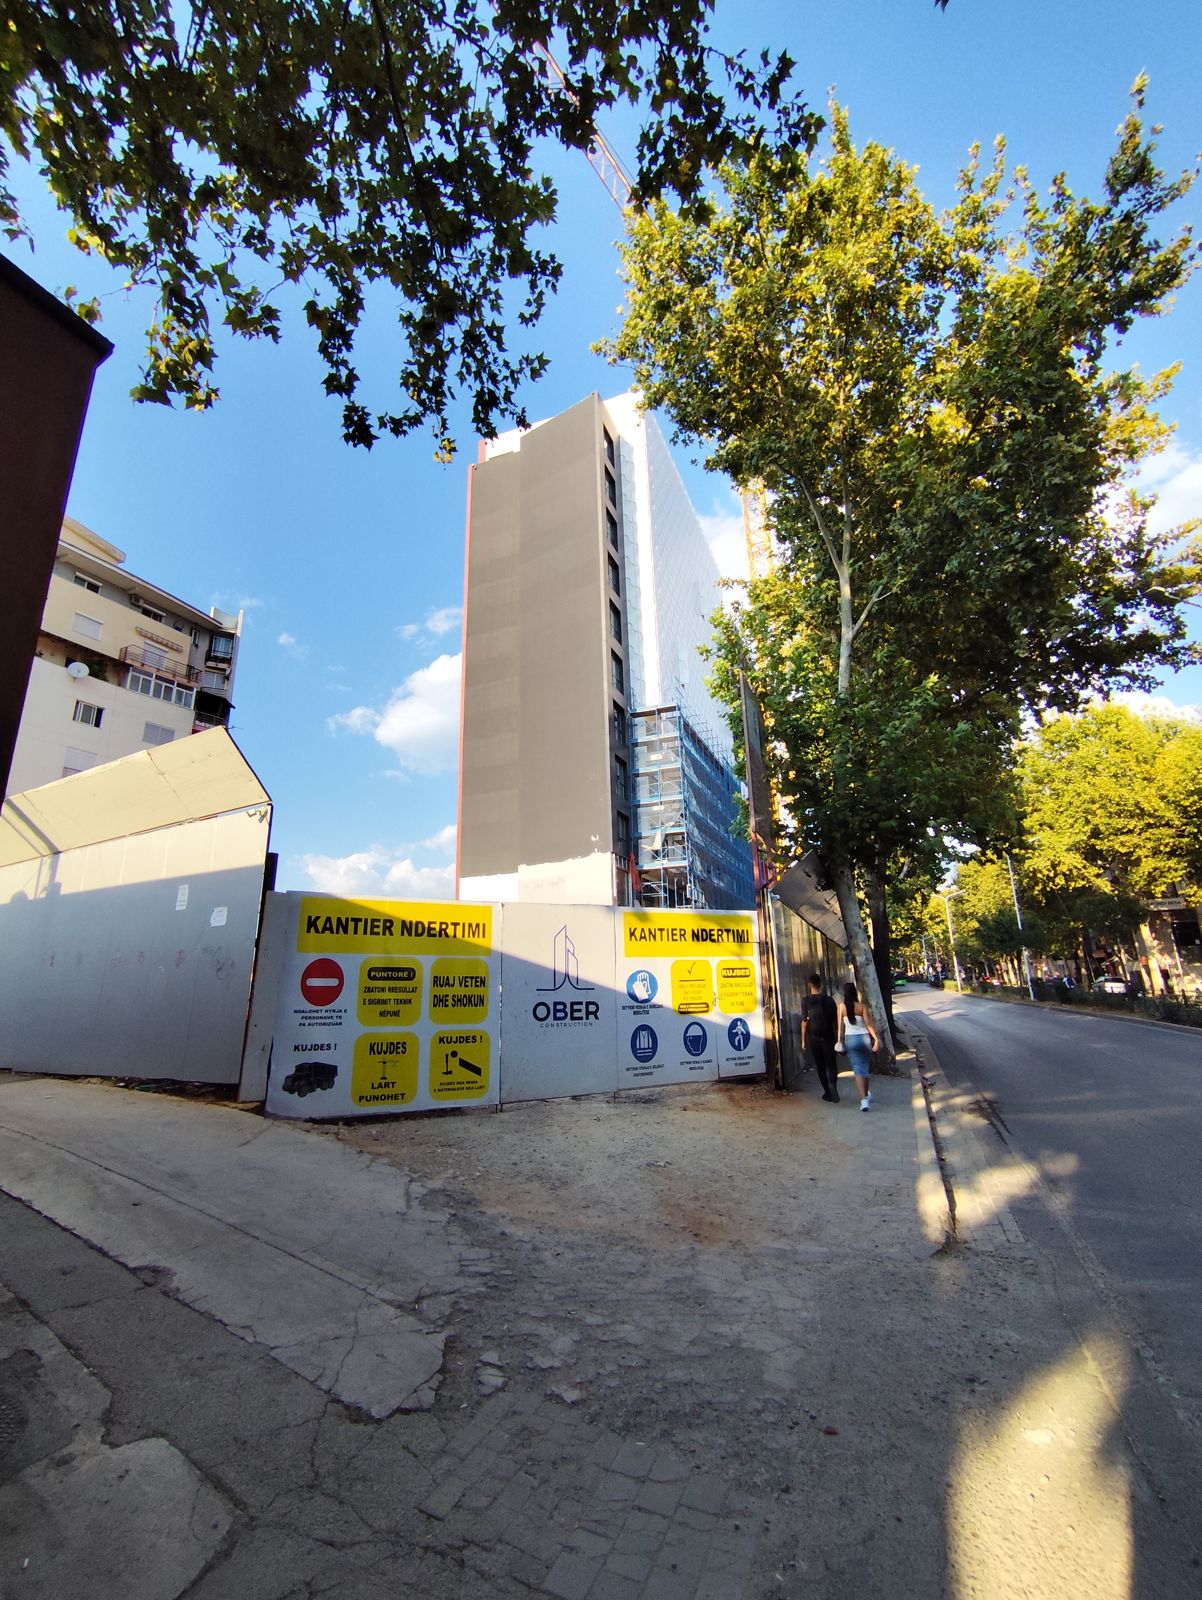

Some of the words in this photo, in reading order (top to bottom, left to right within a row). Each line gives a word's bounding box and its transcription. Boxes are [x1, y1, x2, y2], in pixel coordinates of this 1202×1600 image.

[306, 915, 394, 936] KANTIER
[400, 920, 486, 938] NDERTIMI
[628, 927, 687, 942] KANTIER
[691, 928, 749, 943] NDERTIMI
[433, 976, 455, 988] RUAJ
[458, 976, 486, 988] VETEN
[368, 998, 391, 1006] SIGRIMIT
[393, 998, 413, 1006] TEKNIK
[433, 994, 449, 1007] DHE
[452, 994, 485, 1007] SHOKUN
[532, 1001, 600, 1022] OBER
[439, 1035, 477, 1044] KUJDES
[294, 1043, 331, 1052] KUJDES
[369, 1041, 407, 1055] KUJDES
[358, 1092, 406, 1102] PUNOHET
